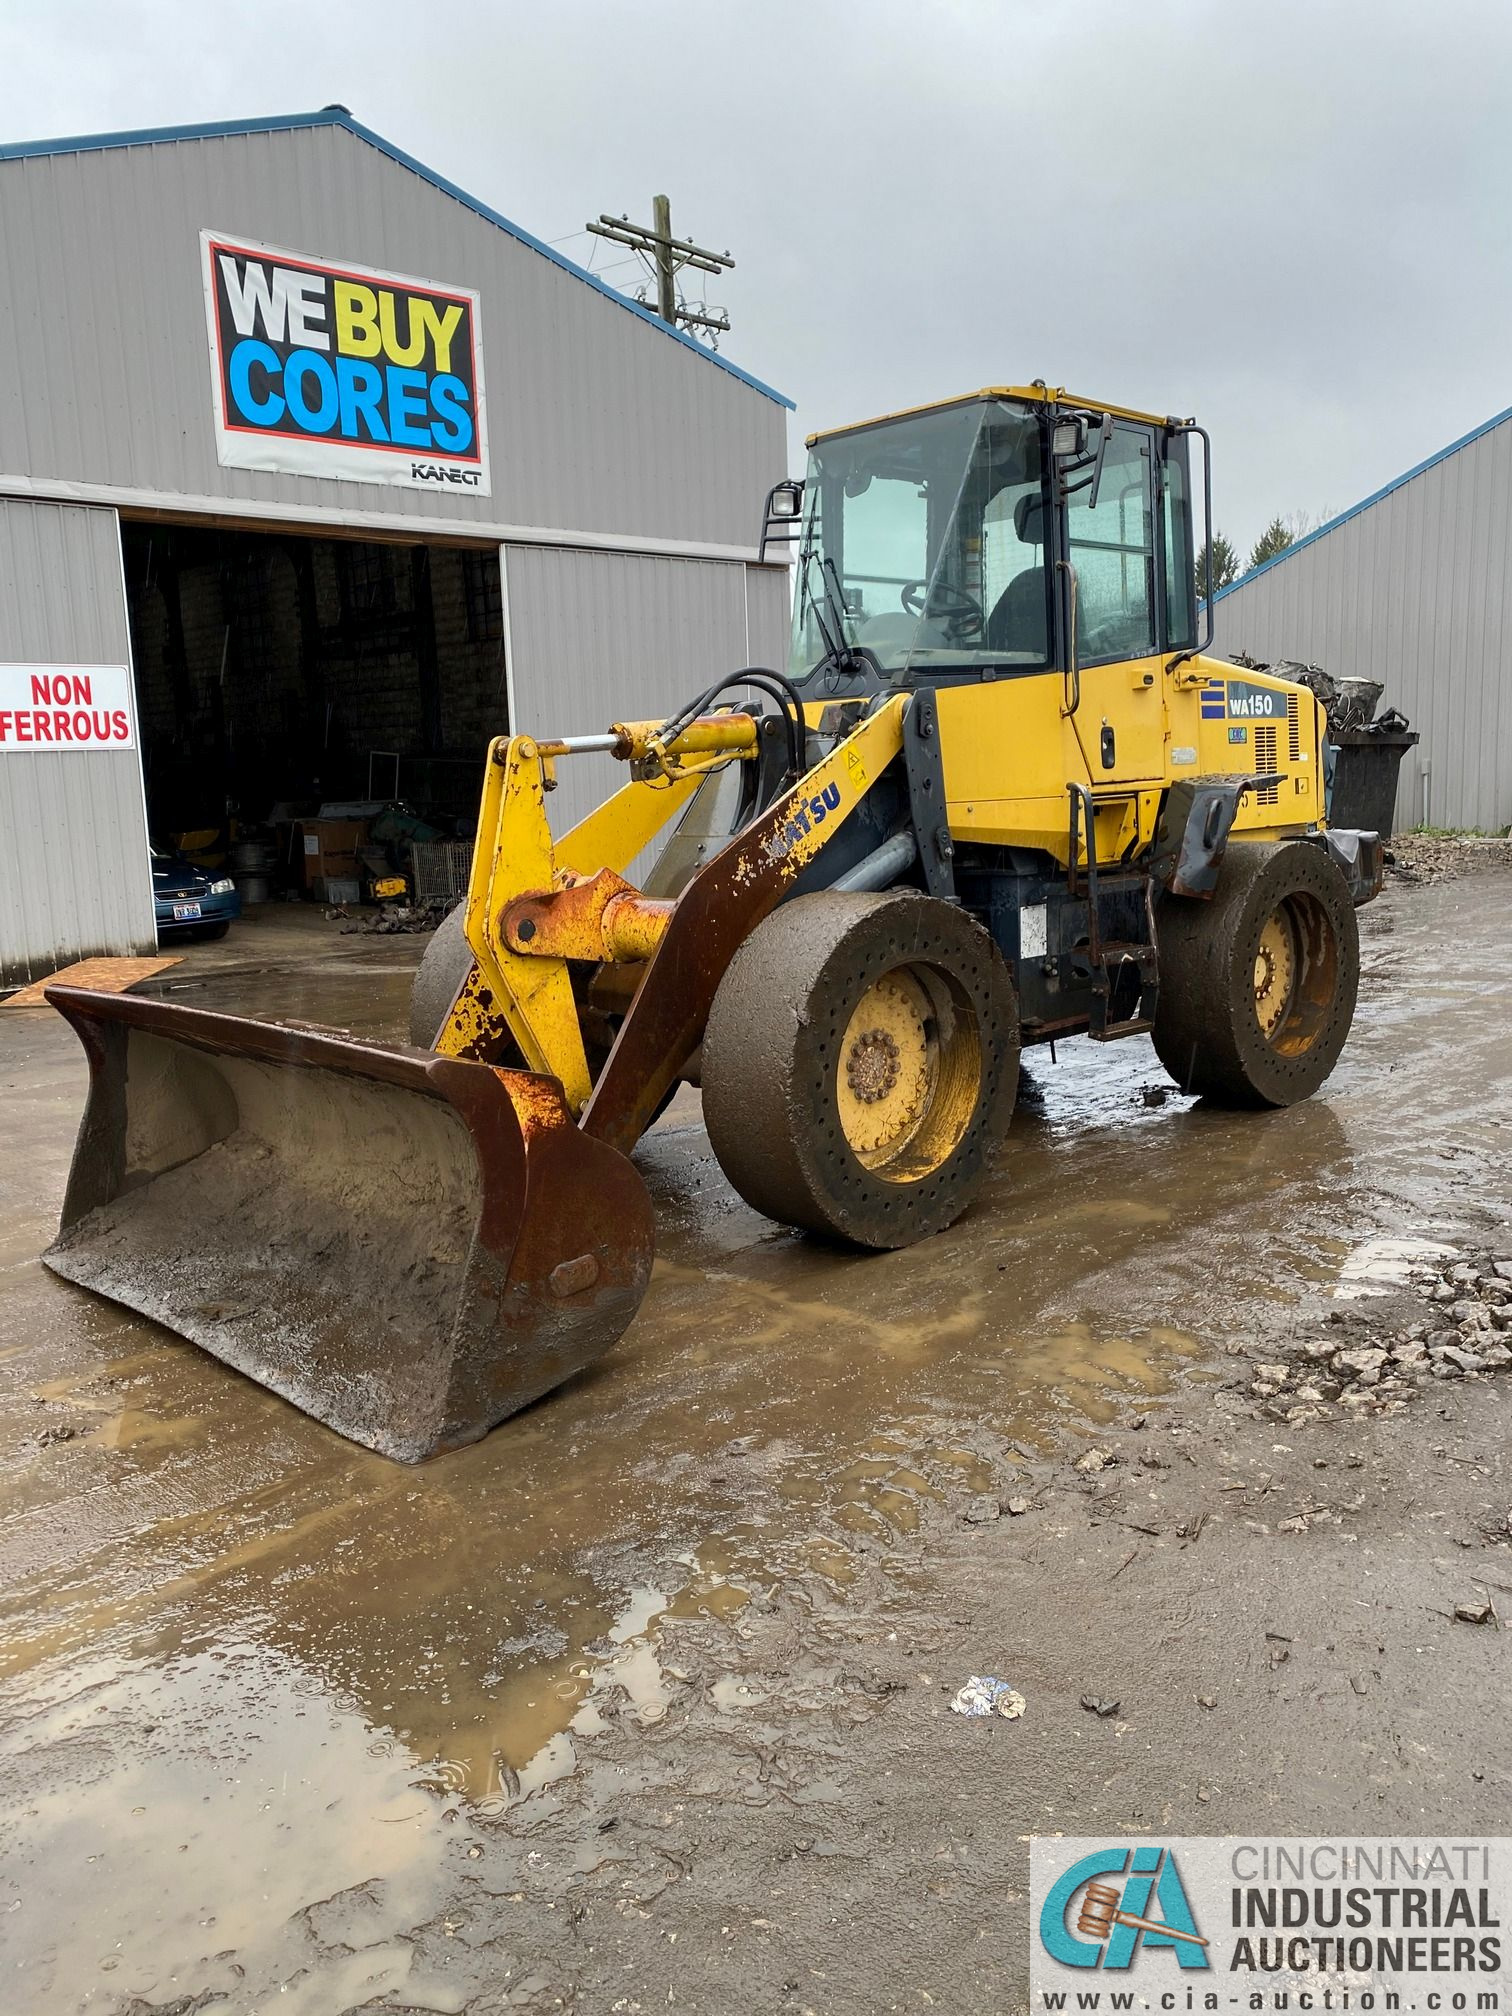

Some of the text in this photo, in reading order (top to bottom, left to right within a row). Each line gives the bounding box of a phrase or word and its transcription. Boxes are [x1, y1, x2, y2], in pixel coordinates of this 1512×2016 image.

[218, 254, 464, 373] WE BUY
[229, 338, 473, 452] CORES
[411, 463, 482, 485] KANECT
[30, 674, 92, 705] NON
[1229, 694, 1273, 715] WA150
[0, 710, 128, 741] FERROUS
